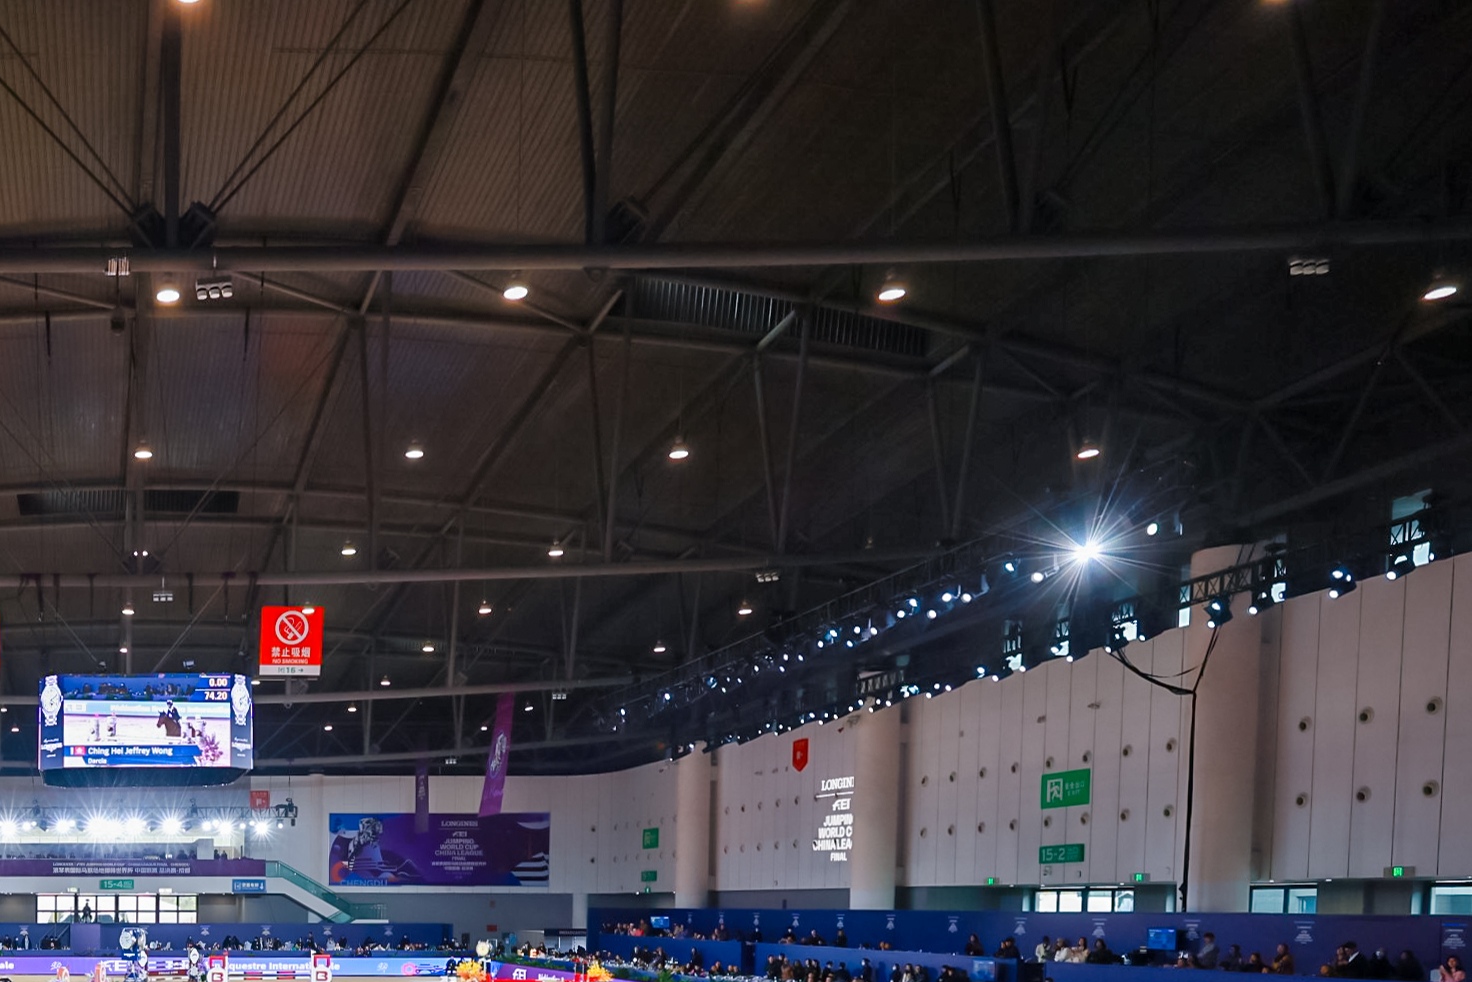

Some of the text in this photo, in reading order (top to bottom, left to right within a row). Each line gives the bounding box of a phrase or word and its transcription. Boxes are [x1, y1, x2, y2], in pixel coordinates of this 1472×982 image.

[271, 646, 311, 658] 禁止吸烟
[209, 678, 227, 687] 0.00
[205, 691, 227, 700] 74.20
[88, 747, 109, 756] Ching
[125, 747, 151, 757] Jeffrey
[152, 747, 173, 757] Wong
[818, 826, 845, 839] WORLD
[1042, 847, 1066, 862] 15-2
